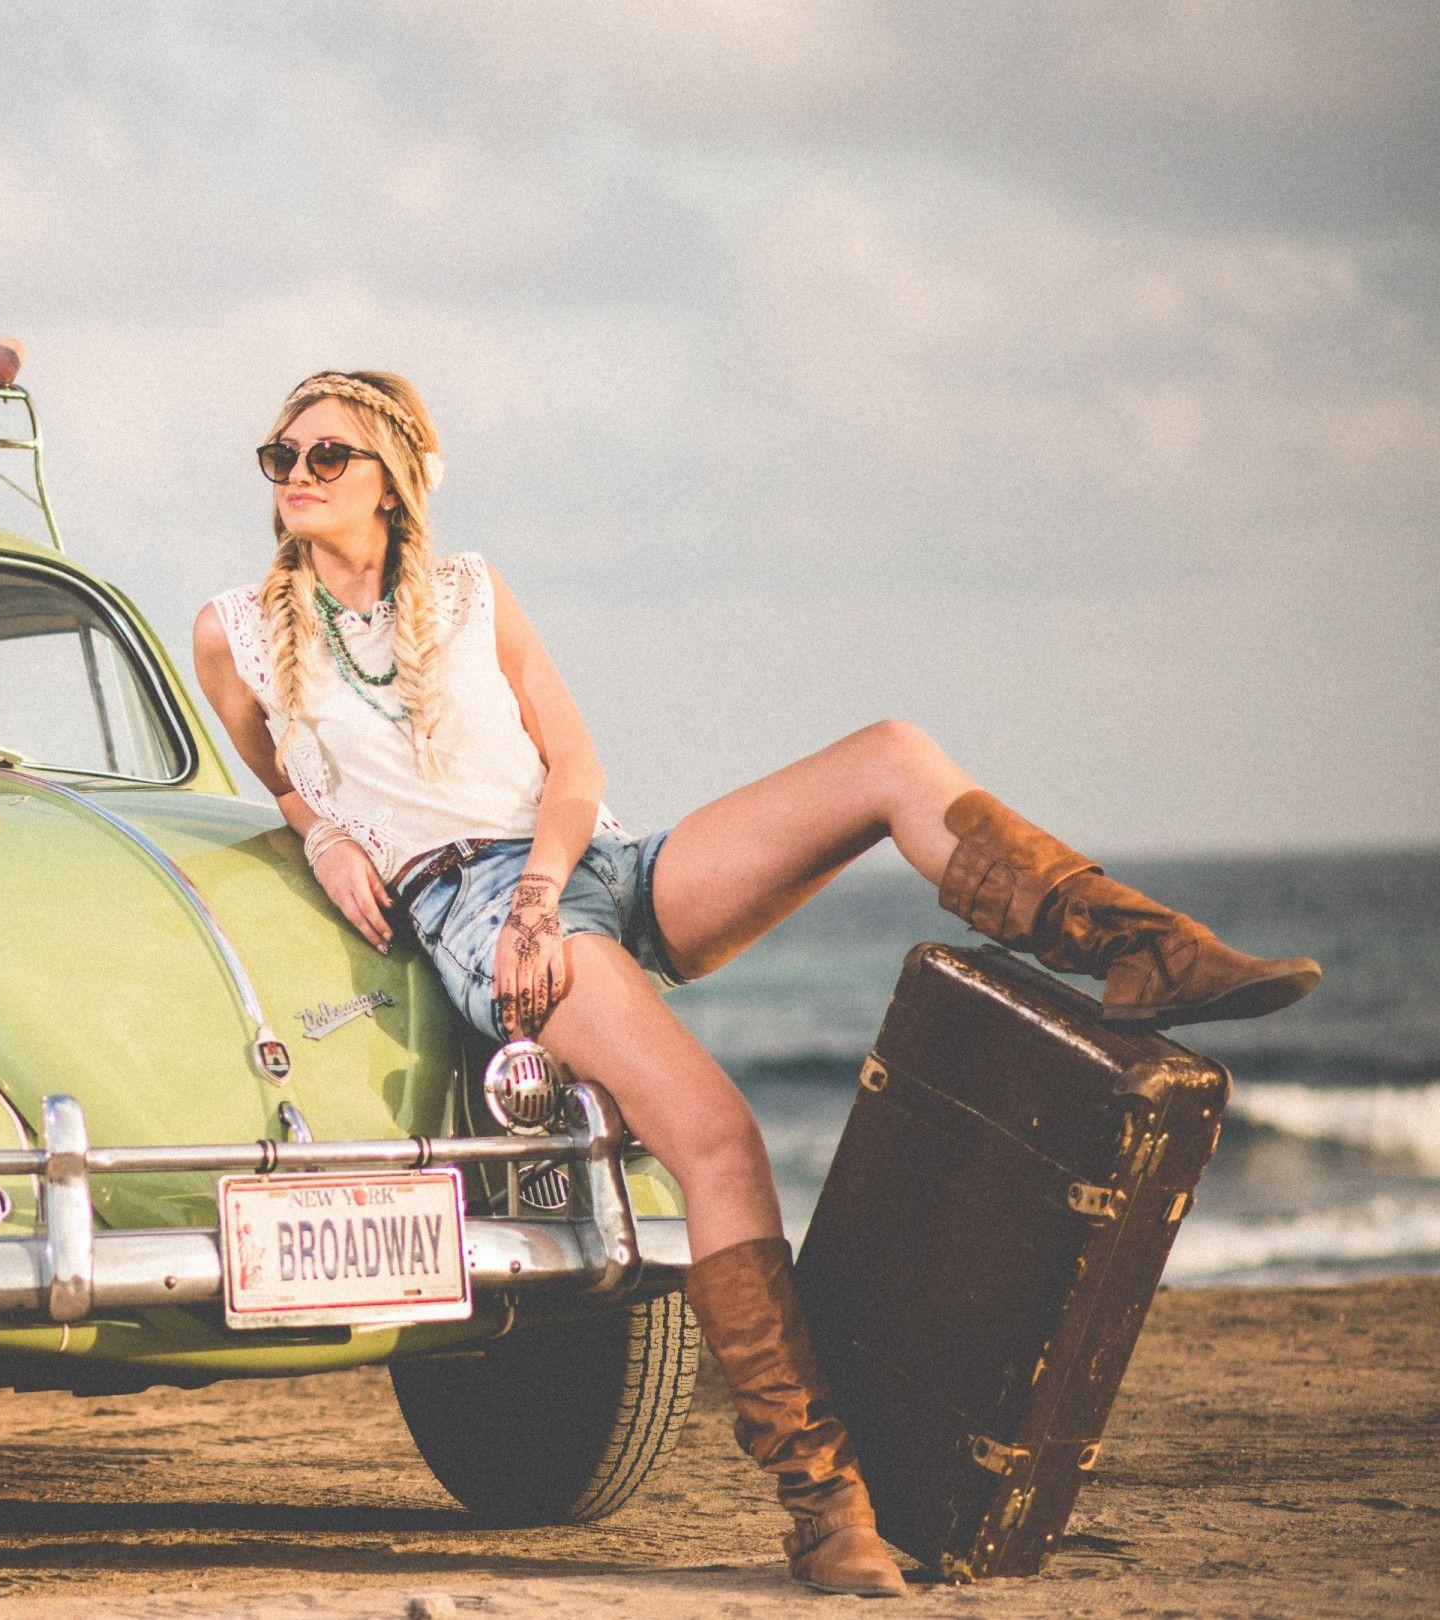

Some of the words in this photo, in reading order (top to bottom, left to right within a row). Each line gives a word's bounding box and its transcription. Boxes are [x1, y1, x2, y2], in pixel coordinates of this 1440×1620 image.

[292, 1188, 335, 1208] NEW
[342, 1186, 396, 1207] YORK
[278, 1214, 442, 1282] BROADWAY
